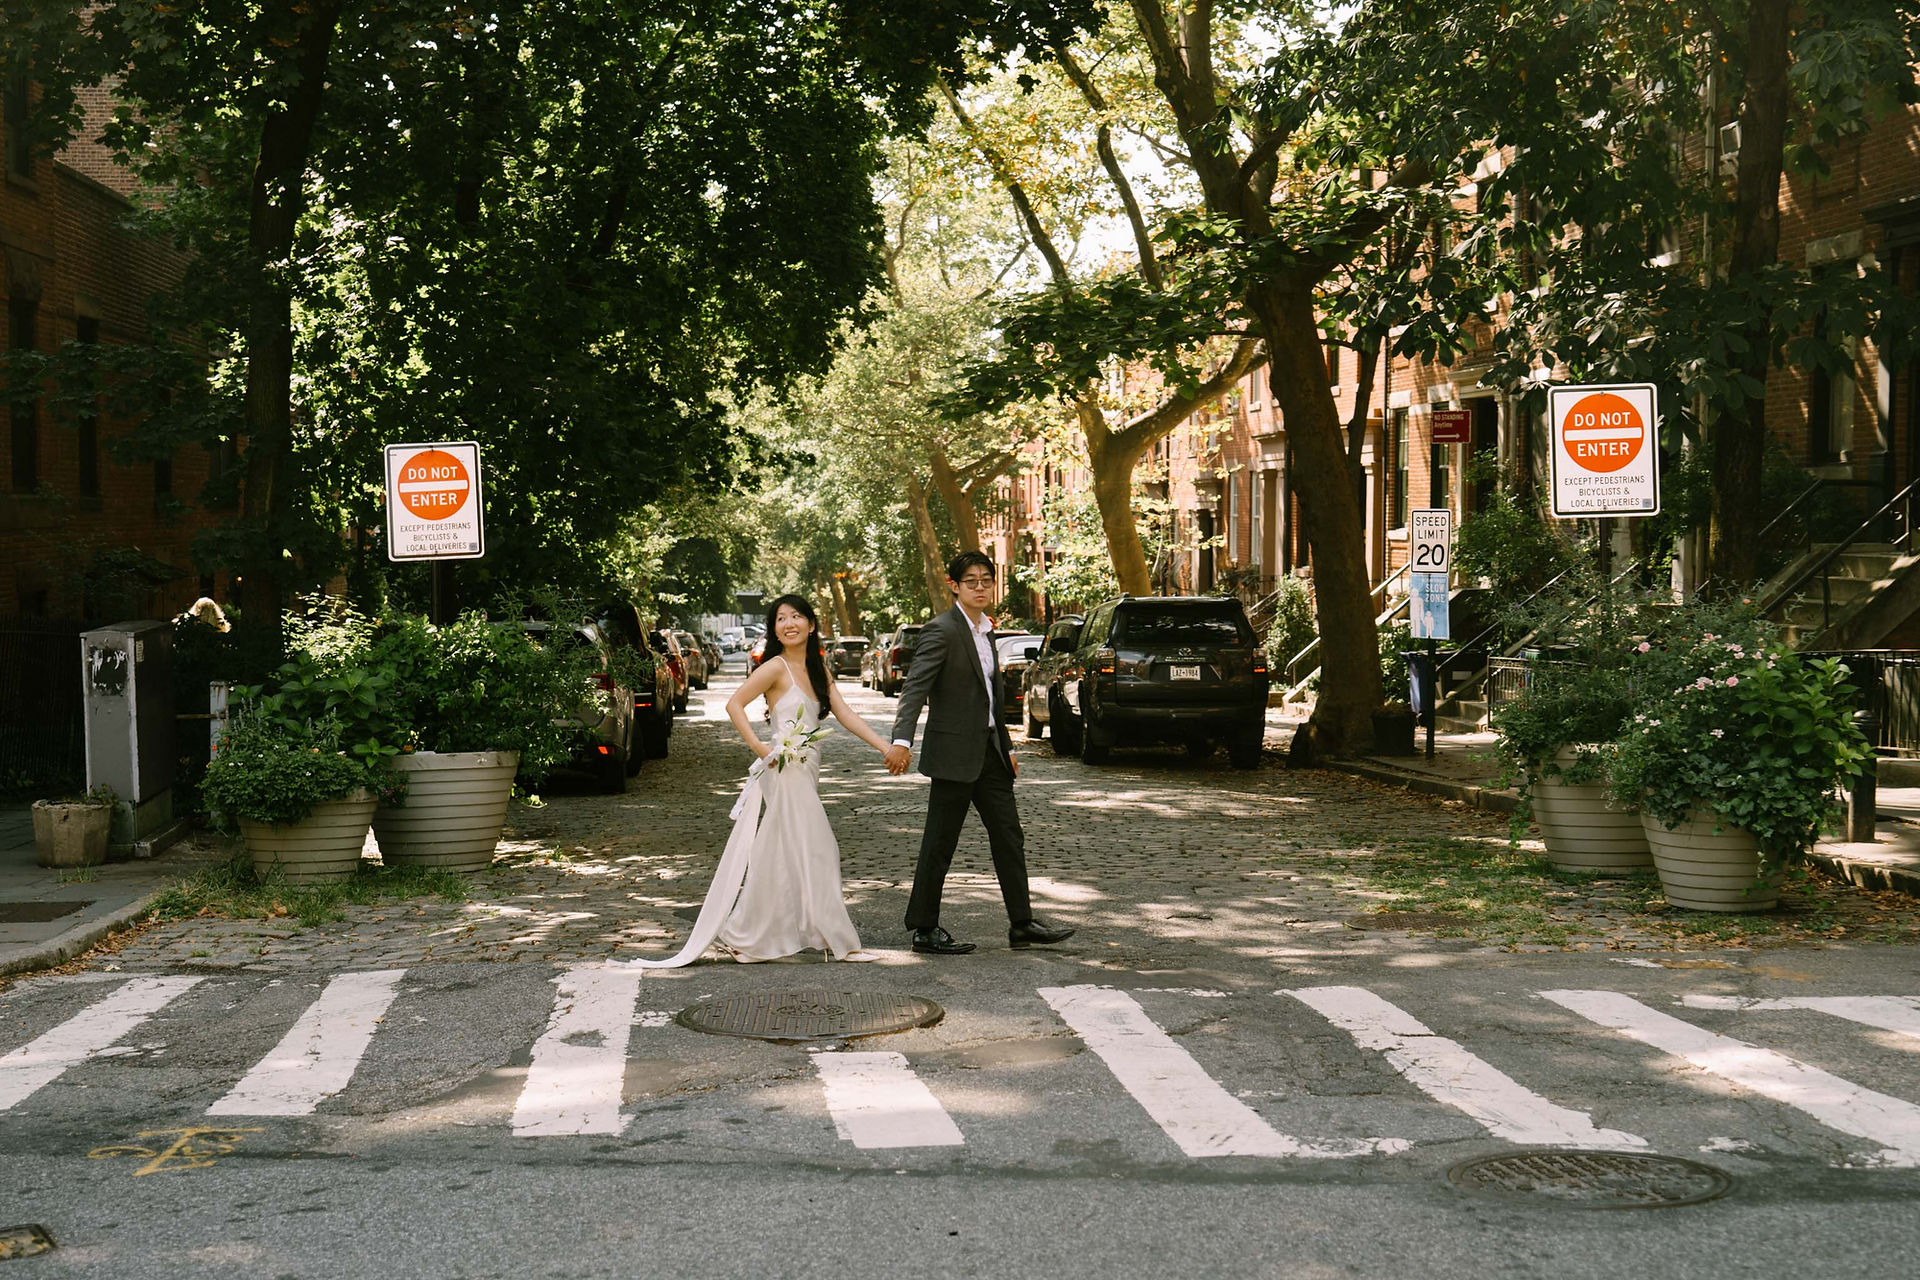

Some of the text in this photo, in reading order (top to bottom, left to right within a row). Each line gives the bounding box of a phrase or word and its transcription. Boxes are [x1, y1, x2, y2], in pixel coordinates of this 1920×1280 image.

[1574, 412, 1631, 427] DO NOT
[1577, 442, 1630, 456] ENTER
[408, 466, 458, 480] DO NOT
[1564, 475, 1645, 485] EXCEPT PEDESTRIANS
[1579, 487, 1630, 496] BICYCLISTS &
[411, 493, 457, 507] ENTER
[1570, 499, 1594, 508] LOCAL
[1597, 498, 1640, 507] DELIVERIES
[1415, 516, 1447, 526] SPEED
[400, 522, 471, 532] EXCEPT PEDESTRIANS
[413, 534, 450, 542] BICYCLISTS
[1417, 530, 1444, 539] LIMIT
[429, 542, 467, 550] DELIVERIES
[1417, 544, 1445, 566] 20
[1425, 594, 1445, 603] ZONE
